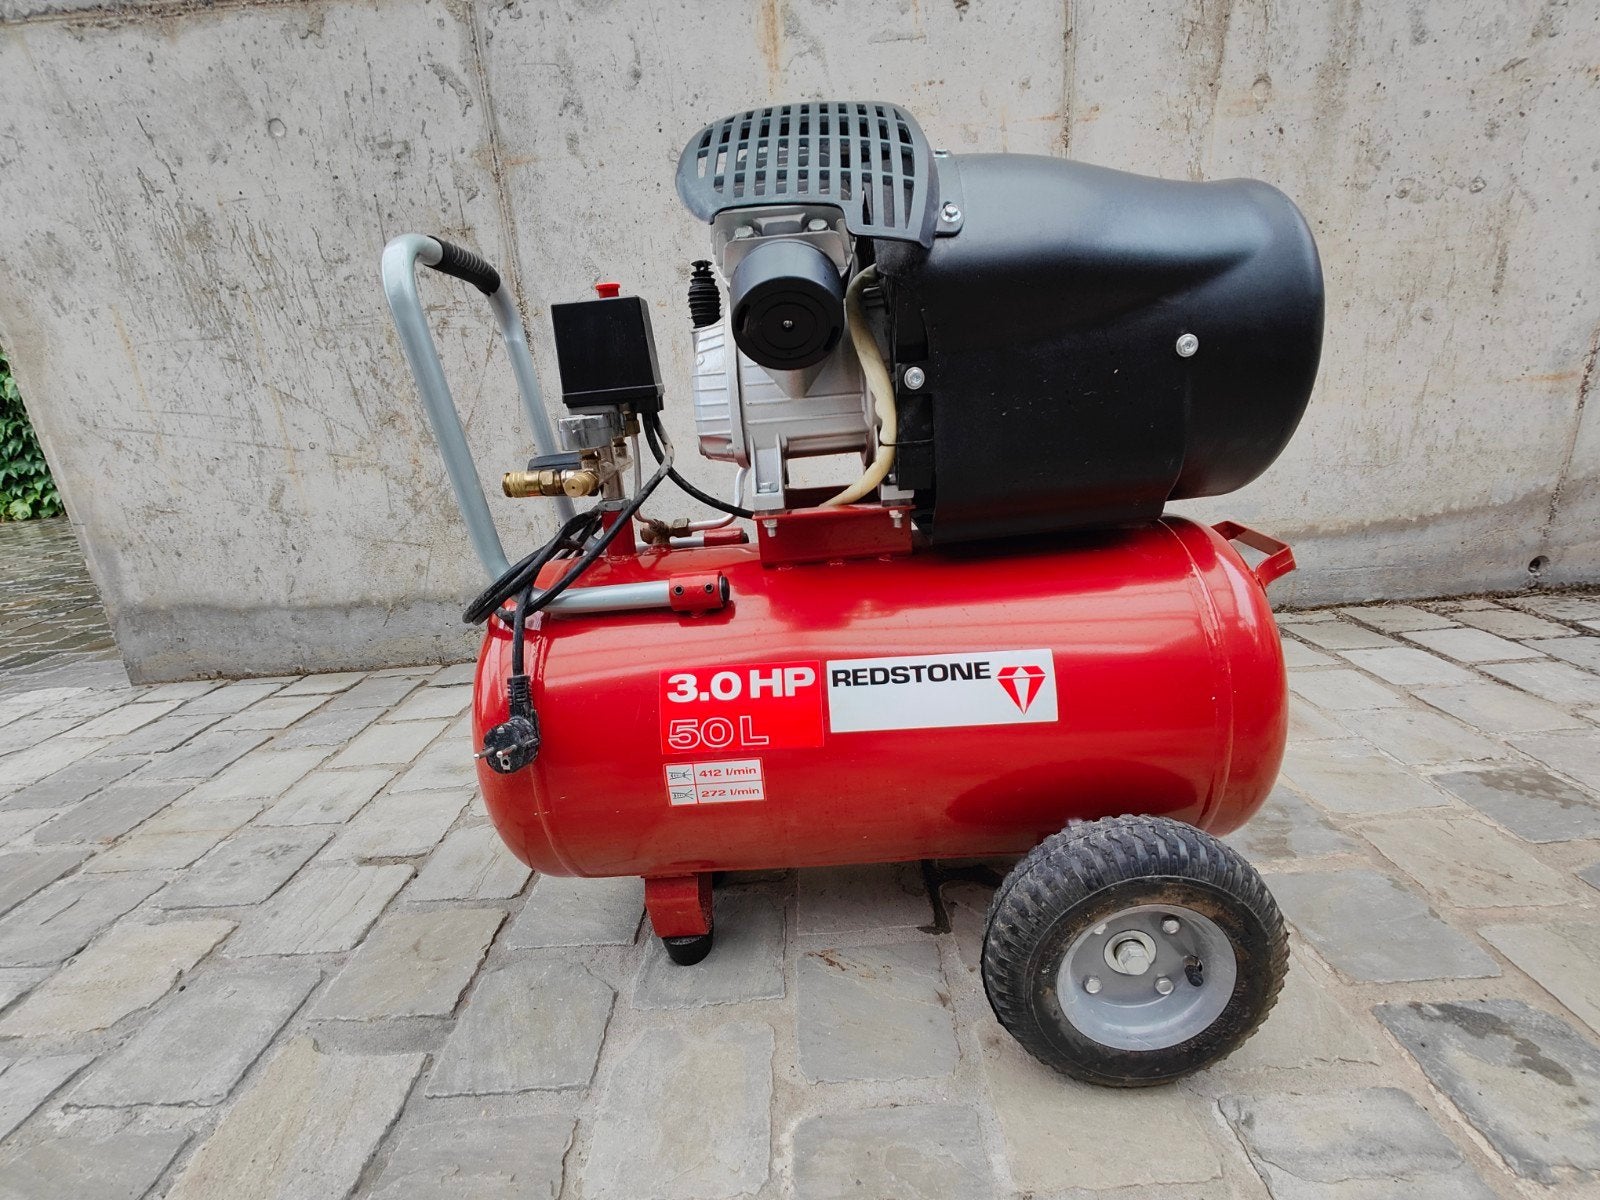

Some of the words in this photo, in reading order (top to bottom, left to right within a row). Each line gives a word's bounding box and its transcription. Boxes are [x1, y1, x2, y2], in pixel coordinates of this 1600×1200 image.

[667, 671, 742, 703] 3.0
[750, 667, 815, 699] HP
[832, 661, 991, 687] REDSTONE
[671, 717, 733, 749] 50
[740, 716, 770, 746] L
[699, 769, 722, 778] 412
[726, 766, 757, 777] l/min
[701, 790, 726, 798] 272
[730, 787, 760, 796] l/min
